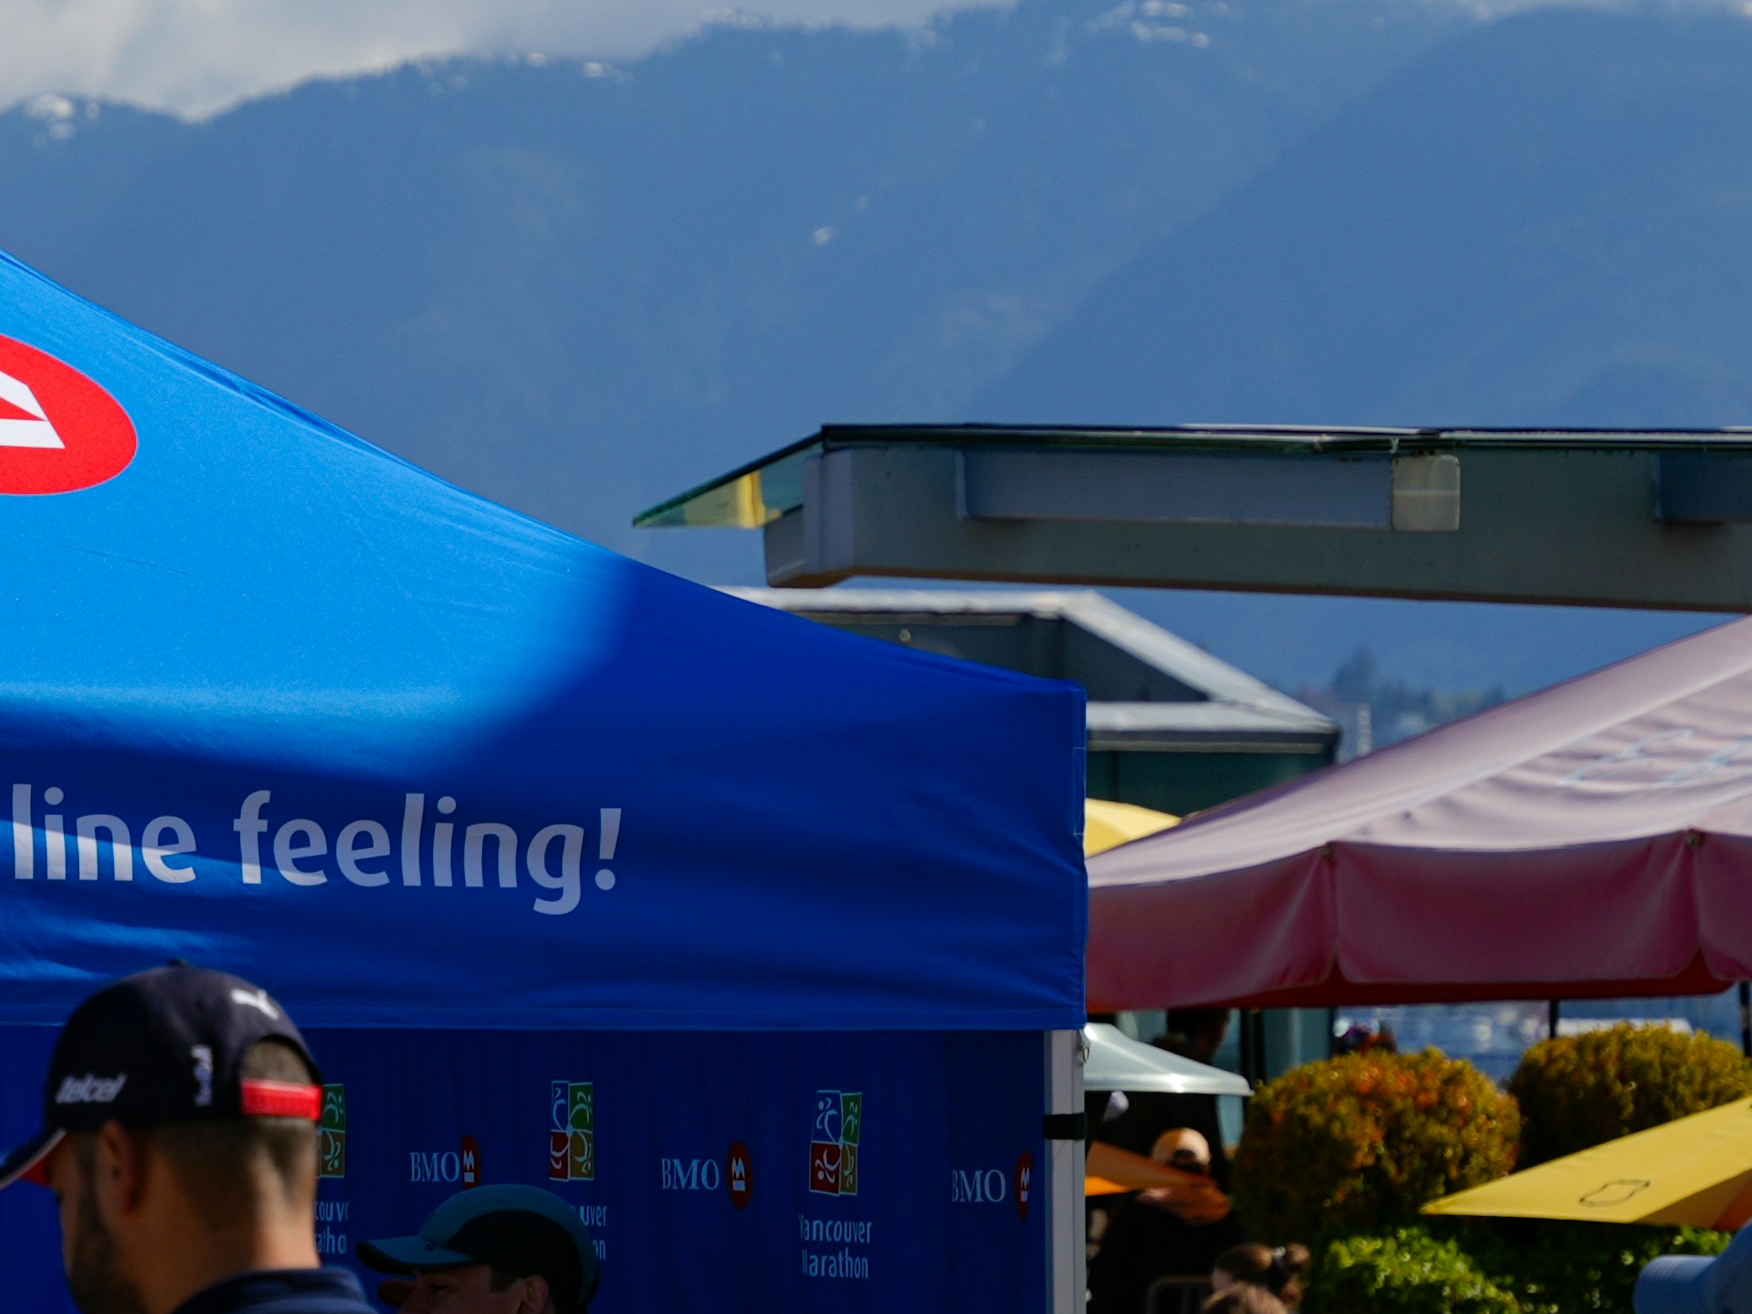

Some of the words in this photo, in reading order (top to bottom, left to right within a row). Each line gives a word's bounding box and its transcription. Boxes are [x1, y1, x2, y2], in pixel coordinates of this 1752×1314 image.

[12, 782, 198, 885] line
[235, 790, 622, 916] feeling!
[409, 1150, 461, 1183] BMO
[661, 1157, 721, 1191] BMO
[951, 1168, 1007, 1204] BMO
